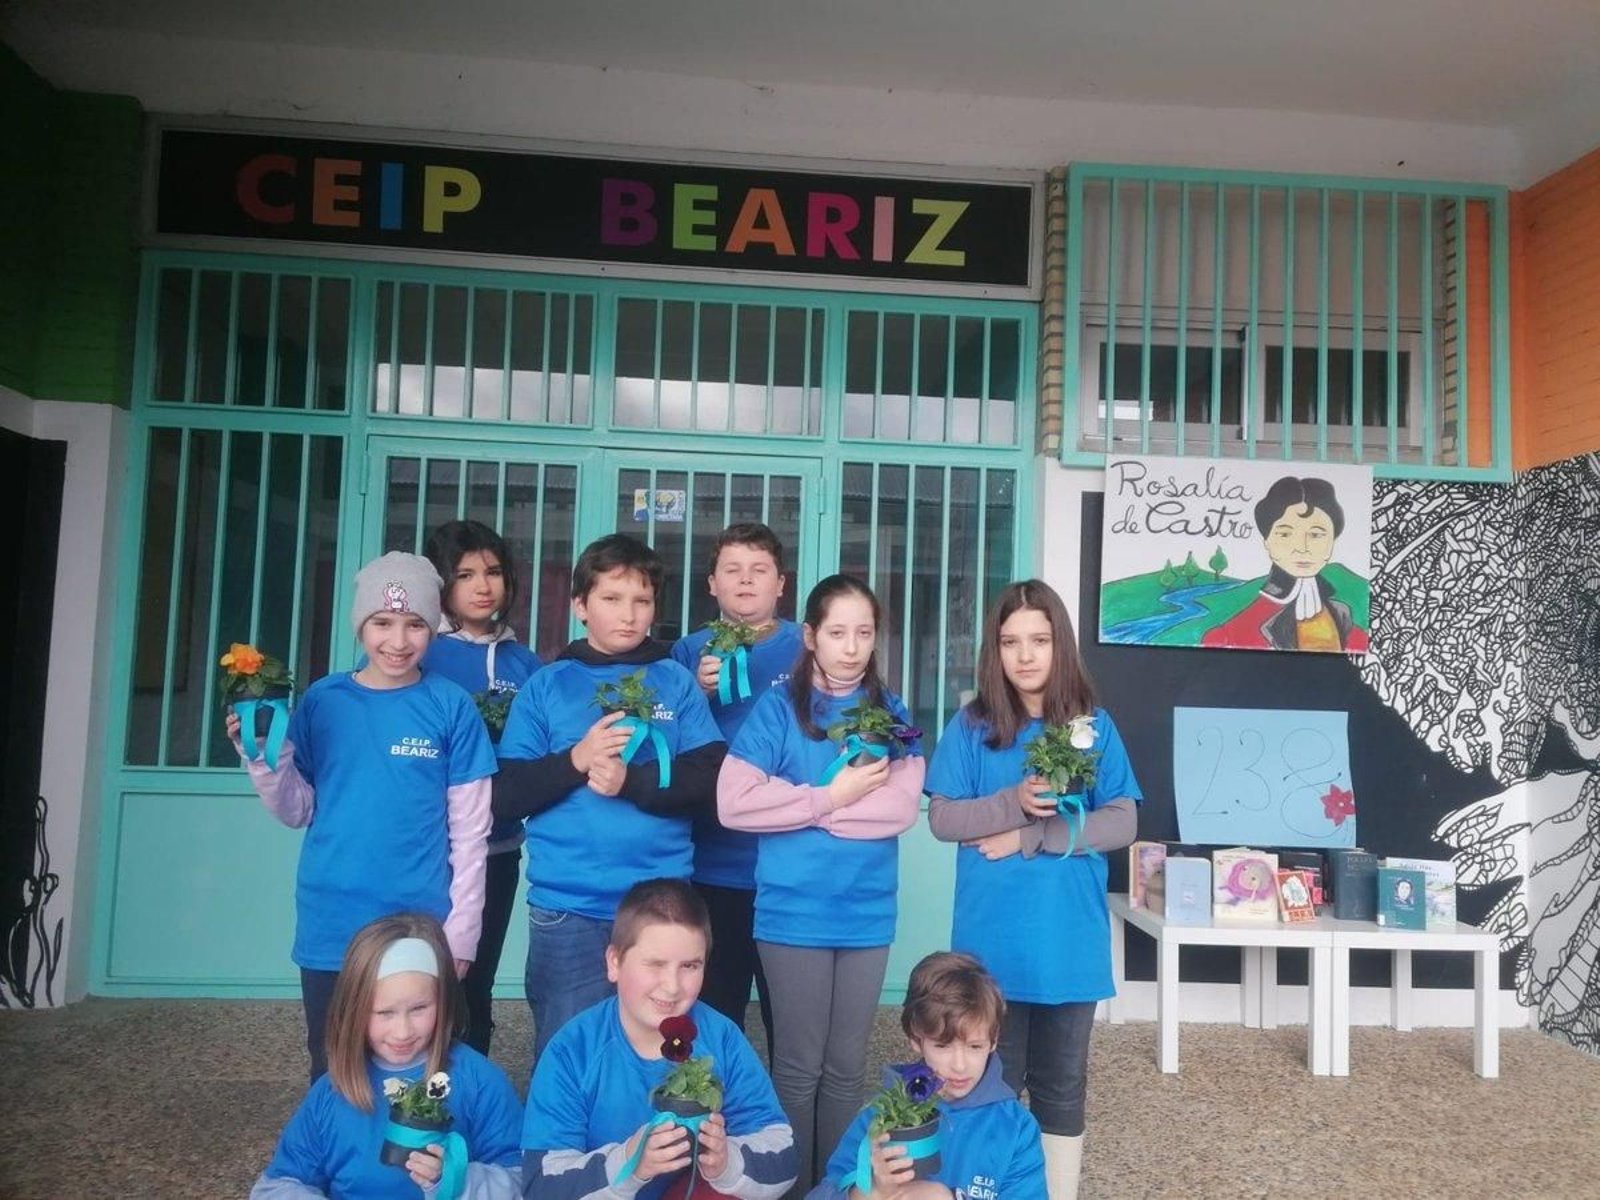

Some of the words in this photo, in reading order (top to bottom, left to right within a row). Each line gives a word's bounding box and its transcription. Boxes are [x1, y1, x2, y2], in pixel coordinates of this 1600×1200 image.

[235, 153, 482, 234] CEIP
[600, 178, 971, 266] BEARIZ
[1109, 460, 1254, 503] Rosalía
[1111, 504, 1141, 535] de
[1144, 501, 1255, 540] Castro
[651, 711, 674, 721] RIZ
[391, 745, 440, 759] BEARIZ
[1191, 726, 1342, 839] 238
